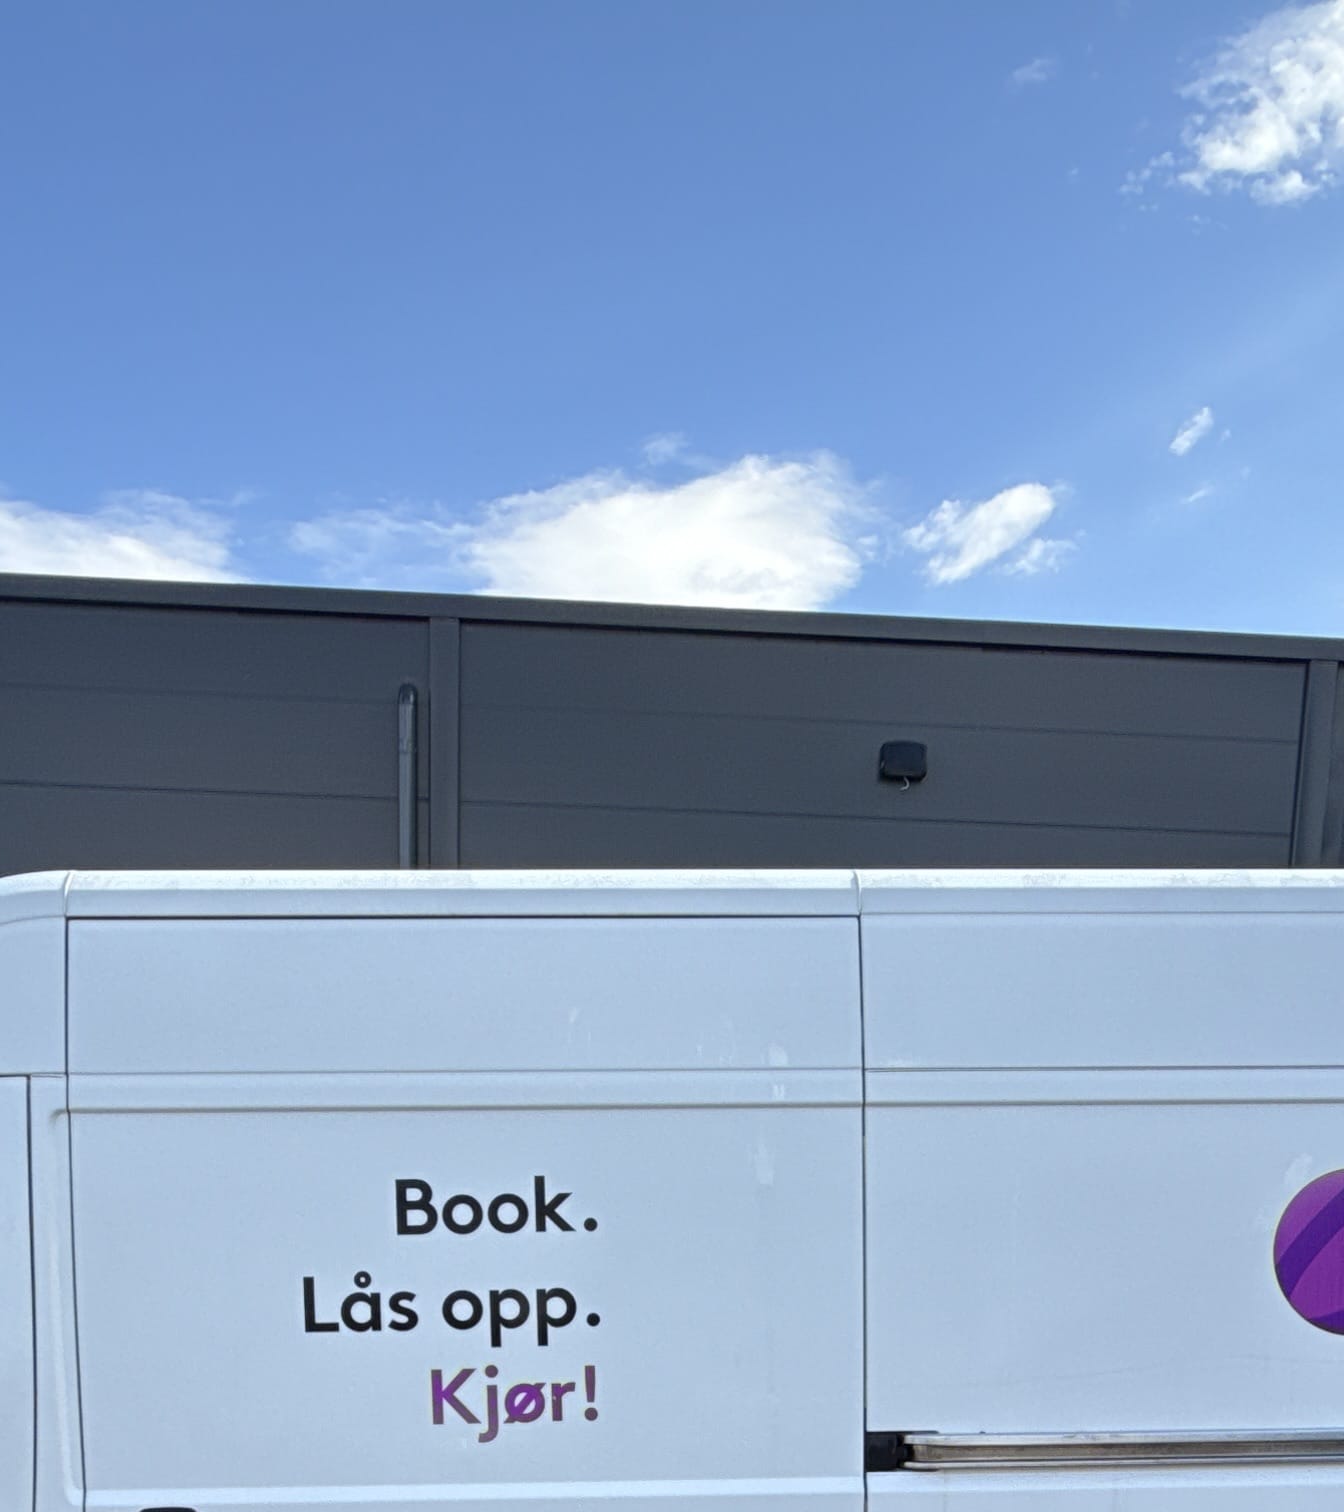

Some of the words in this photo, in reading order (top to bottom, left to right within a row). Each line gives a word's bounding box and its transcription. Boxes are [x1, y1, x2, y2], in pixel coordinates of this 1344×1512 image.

[395, 1175, 598, 1235] Book.
[303, 1270, 419, 1333] Lås
[442, 1287, 601, 1348] opp.
[430, 1364, 599, 1443] Kjør!
